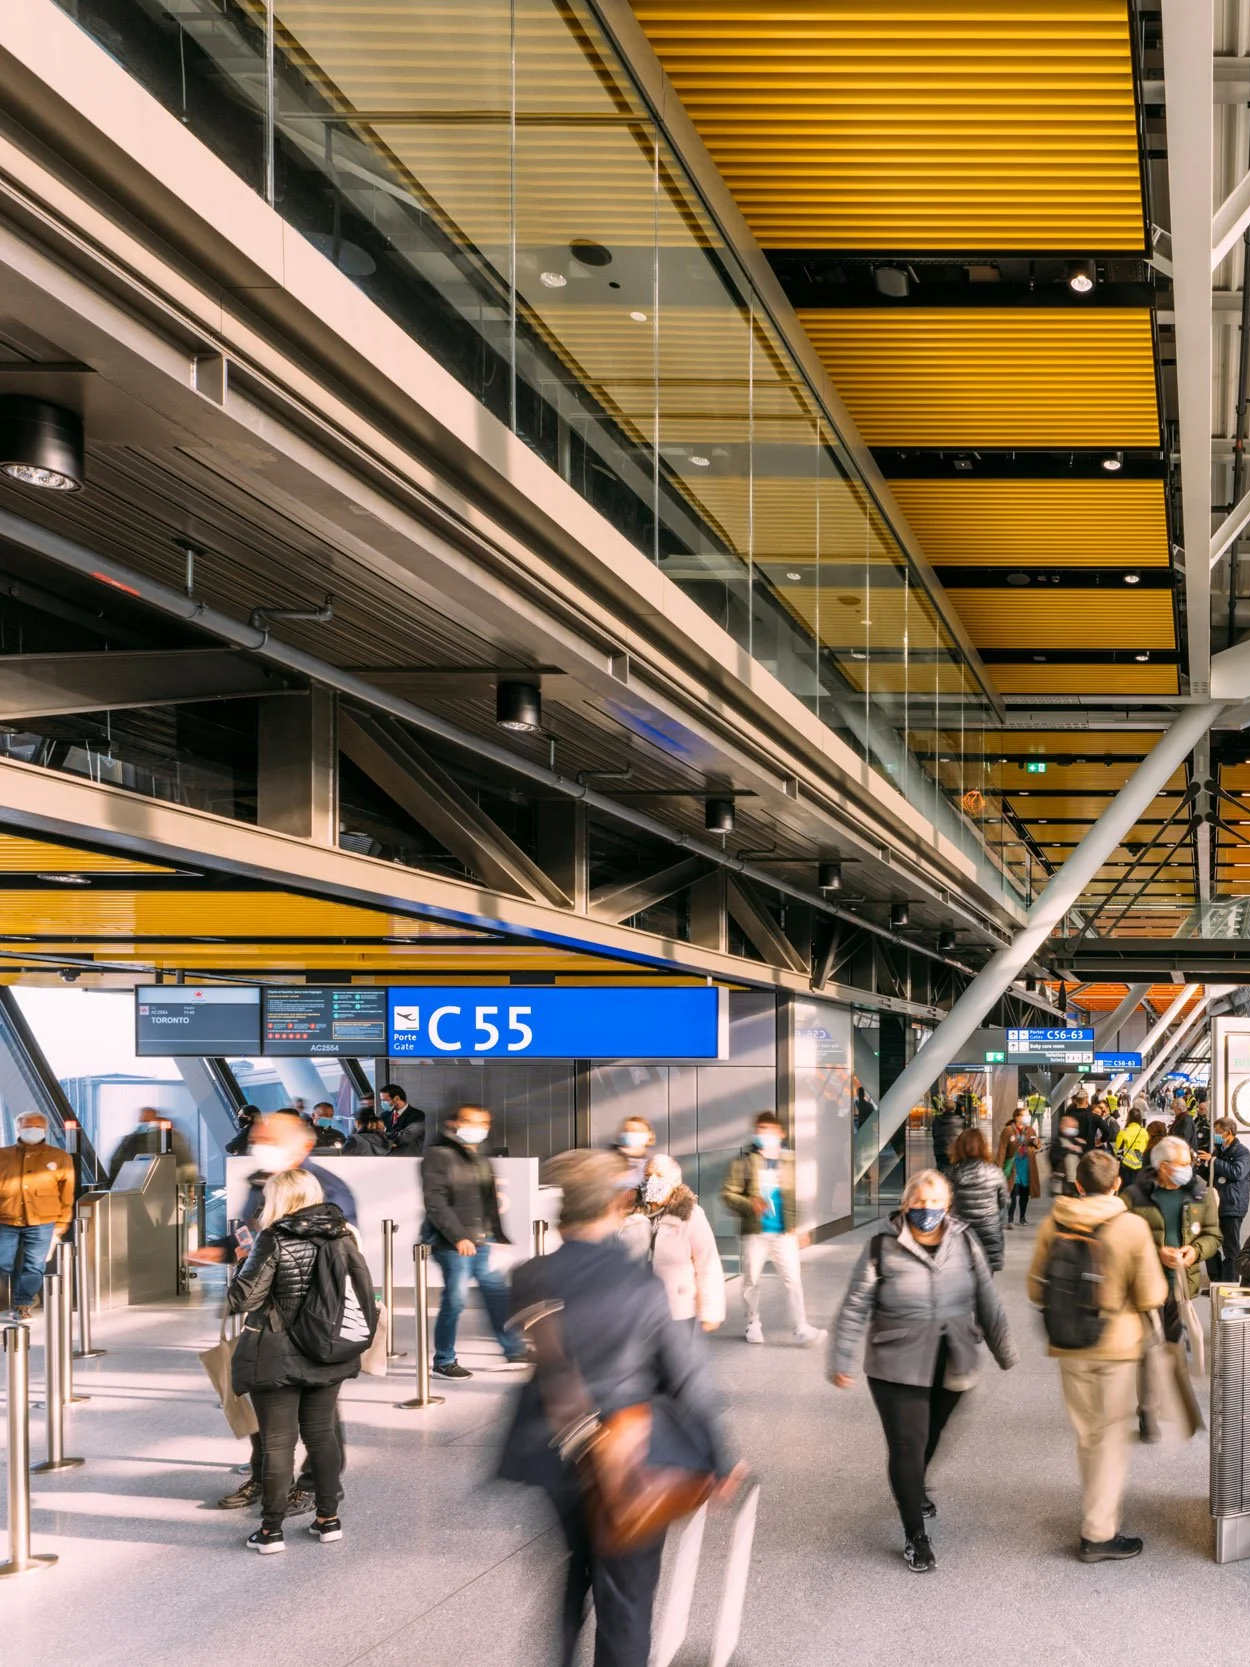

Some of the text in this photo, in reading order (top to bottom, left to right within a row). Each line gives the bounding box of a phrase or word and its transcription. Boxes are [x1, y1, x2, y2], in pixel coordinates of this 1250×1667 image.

[393, 1033, 417, 1041] Porte
[310, 1044, 339, 1052] AC2554
[393, 1042, 414, 1051] Gate
